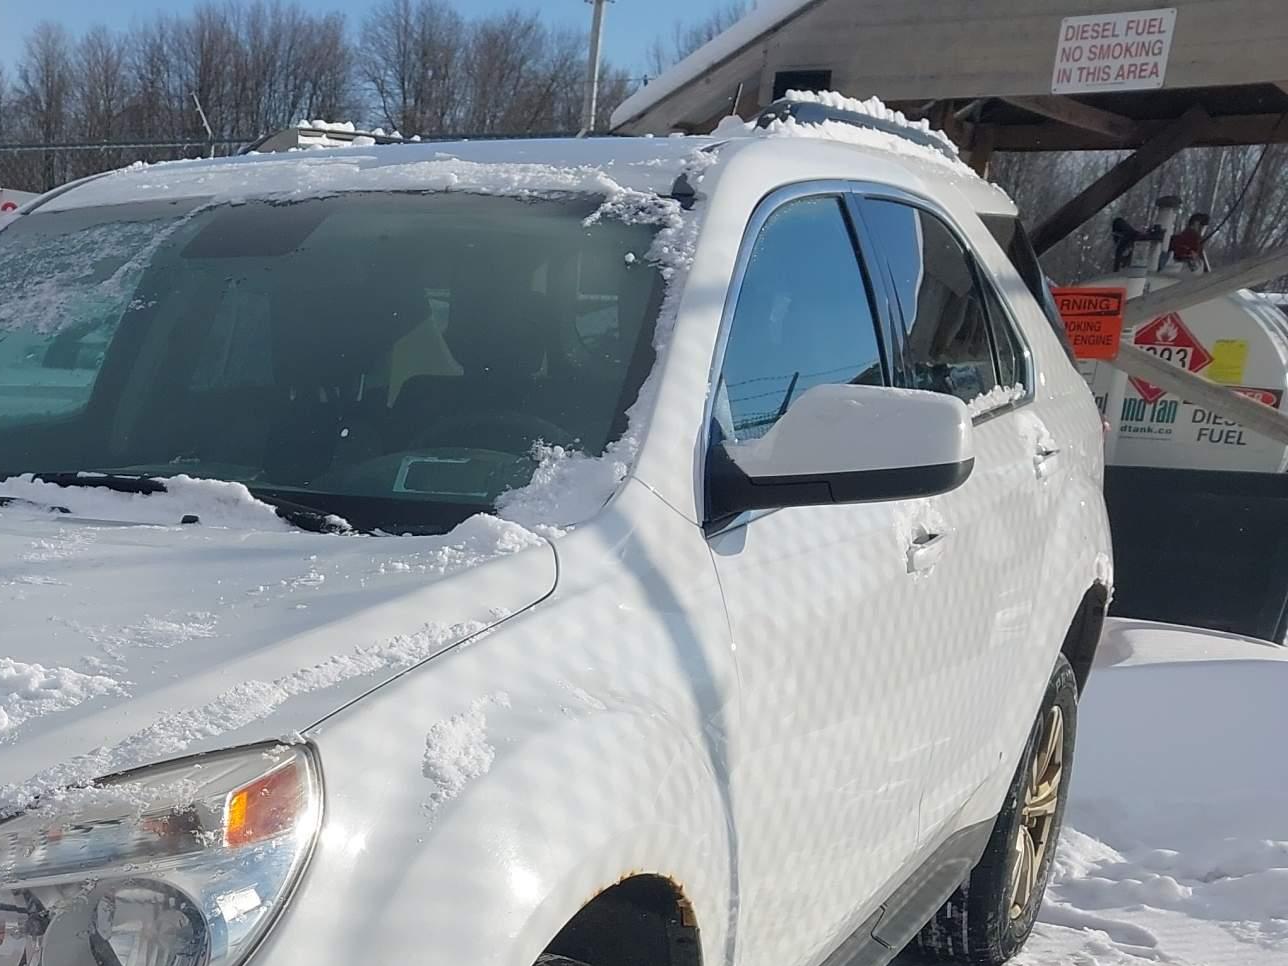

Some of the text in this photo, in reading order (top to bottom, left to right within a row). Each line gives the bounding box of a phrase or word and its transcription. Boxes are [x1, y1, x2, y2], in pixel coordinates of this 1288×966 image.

[1064, 17, 1166, 41] DIESEL FUEL
[1060, 39, 1164, 63] NO SMOKING
[1057, 62, 1160, 84] IN THIS AREA
[1064, 321, 1101, 332] OKING
[1073, 334, 1113, 346] ENGINE
[1196, 427, 1247, 446] FUEL
